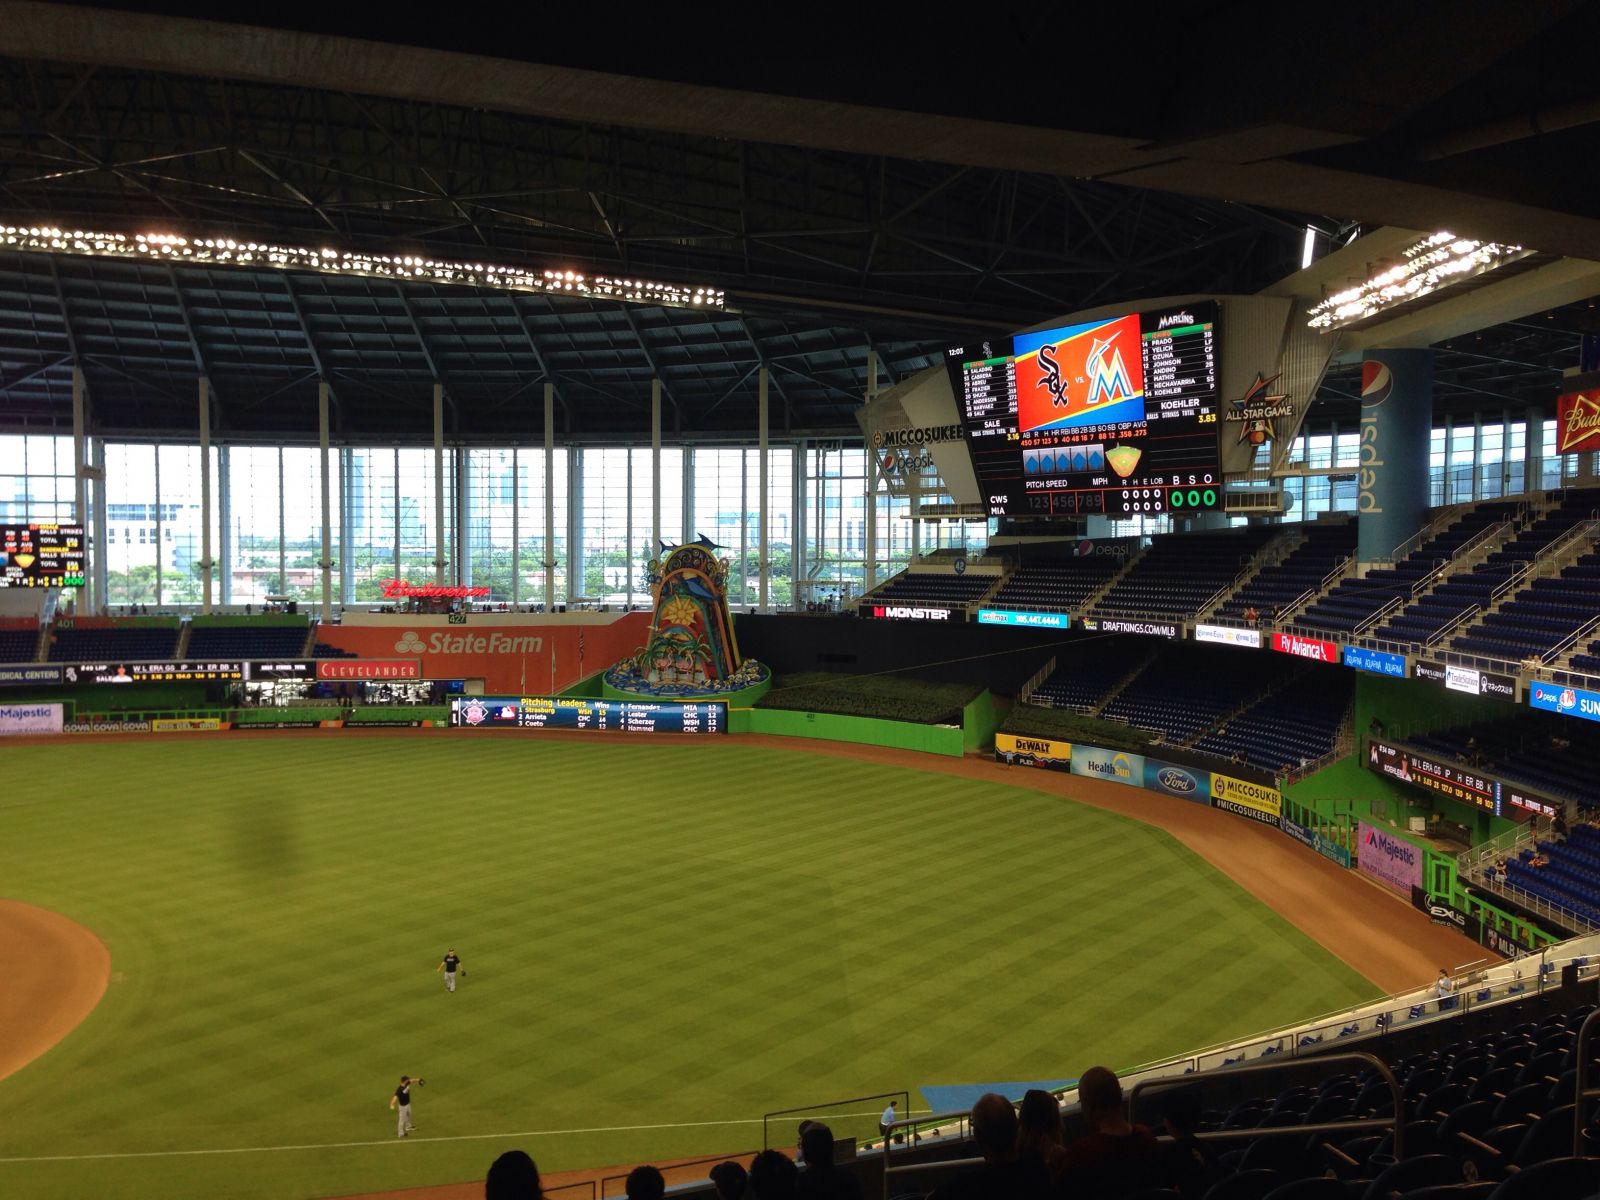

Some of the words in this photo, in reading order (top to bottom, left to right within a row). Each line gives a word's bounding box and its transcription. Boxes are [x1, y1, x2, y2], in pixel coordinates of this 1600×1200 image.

[1152, 338, 1172, 346] PRADO
[949, 348, 964, 356] 12:03
[1152, 345, 1173, 353] YELICH
[1153, 353, 1173, 361] OZUNA
[1153, 359, 1181, 368] JOHNSON
[1153, 367, 1176, 375] ANDINO
[1154, 374, 1175, 382] MATHIS
[1154, 379, 1196, 389] HECHAVARRIA
[1155, 388, 1182, 396] KOEHLER
[973, 397, 997, 405] ANDERSON
[1161, 399, 1200, 410] KOEHLER
[1199, 414, 1217, 423] 3.83
[1226, 411, 1242, 421] ALL
[1243, 409, 1264, 420] STAR
[1265, 406, 1293, 418] GAME
[984, 420, 1001, 428] SALE
[1118, 422, 1132, 430] OBP
[884, 425, 964, 447] MICCOSUKEE
[896, 452, 935, 473] pepsi
[1359, 412, 1384, 513] pepsi
[1026, 480, 1045, 489] PITCH
[1046, 480, 1068, 488] SPEED
[1093, 478, 1108, 486] MPH
[1173, 476, 1180, 485] B
[1189, 475, 1196, 485] S
[1204, 474, 1213, 484] O
[990, 496, 1008, 504] CWS
[1172, 491, 1184, 507] 0
[1188, 490, 1200, 507] 0
[1204, 490, 1216, 506] 0
[991, 507, 1006, 515] MIA
[1096, 544, 1129, 557] pepsi
[956, 562, 965, 571] 42
[886, 607, 948, 620] MONSTER
[449, 615, 466, 624] 427
[1102, 621, 1175, 637] DRAFTKINGS.COM/MLB
[1281, 636, 1290, 650] Fly
[1292, 637, 1320, 660] Avianca
[322, 663, 415, 677] CLEVELANDER
[1347, 656, 1362, 667] AQUAFINA
[1365, 659, 1382, 671] AQUAFINA
[1385, 662, 1402, 675] AQUAFINA
[0, 671, 24, 680] DICAL
[25, 671, 59, 679] CENTERS
[521, 698, 553, 708] Pitching
[557, 700, 587, 708] Leaders
[1, 708, 52, 720] Majestic
[1165, 770, 1189, 790] Ford
[1412, 758, 1418, 767] W
[1423, 762, 1433, 774] ERA
[1434, 766, 1442, 776] GS
[1466, 776, 1474, 787] ER
[1476, 780, 1484, 790] BB
[1487, 784, 1492, 793] K
[1228, 781, 1278, 805] MICCOSUKEE
[1466, 793, 1472, 801] 54
[1485, 799, 1494, 809] 102
[1217, 799, 1278, 826] #MICCOSUKEELIFE
[1379, 834, 1414, 866] Majestic
[1499, 938, 1515, 957] MLB
